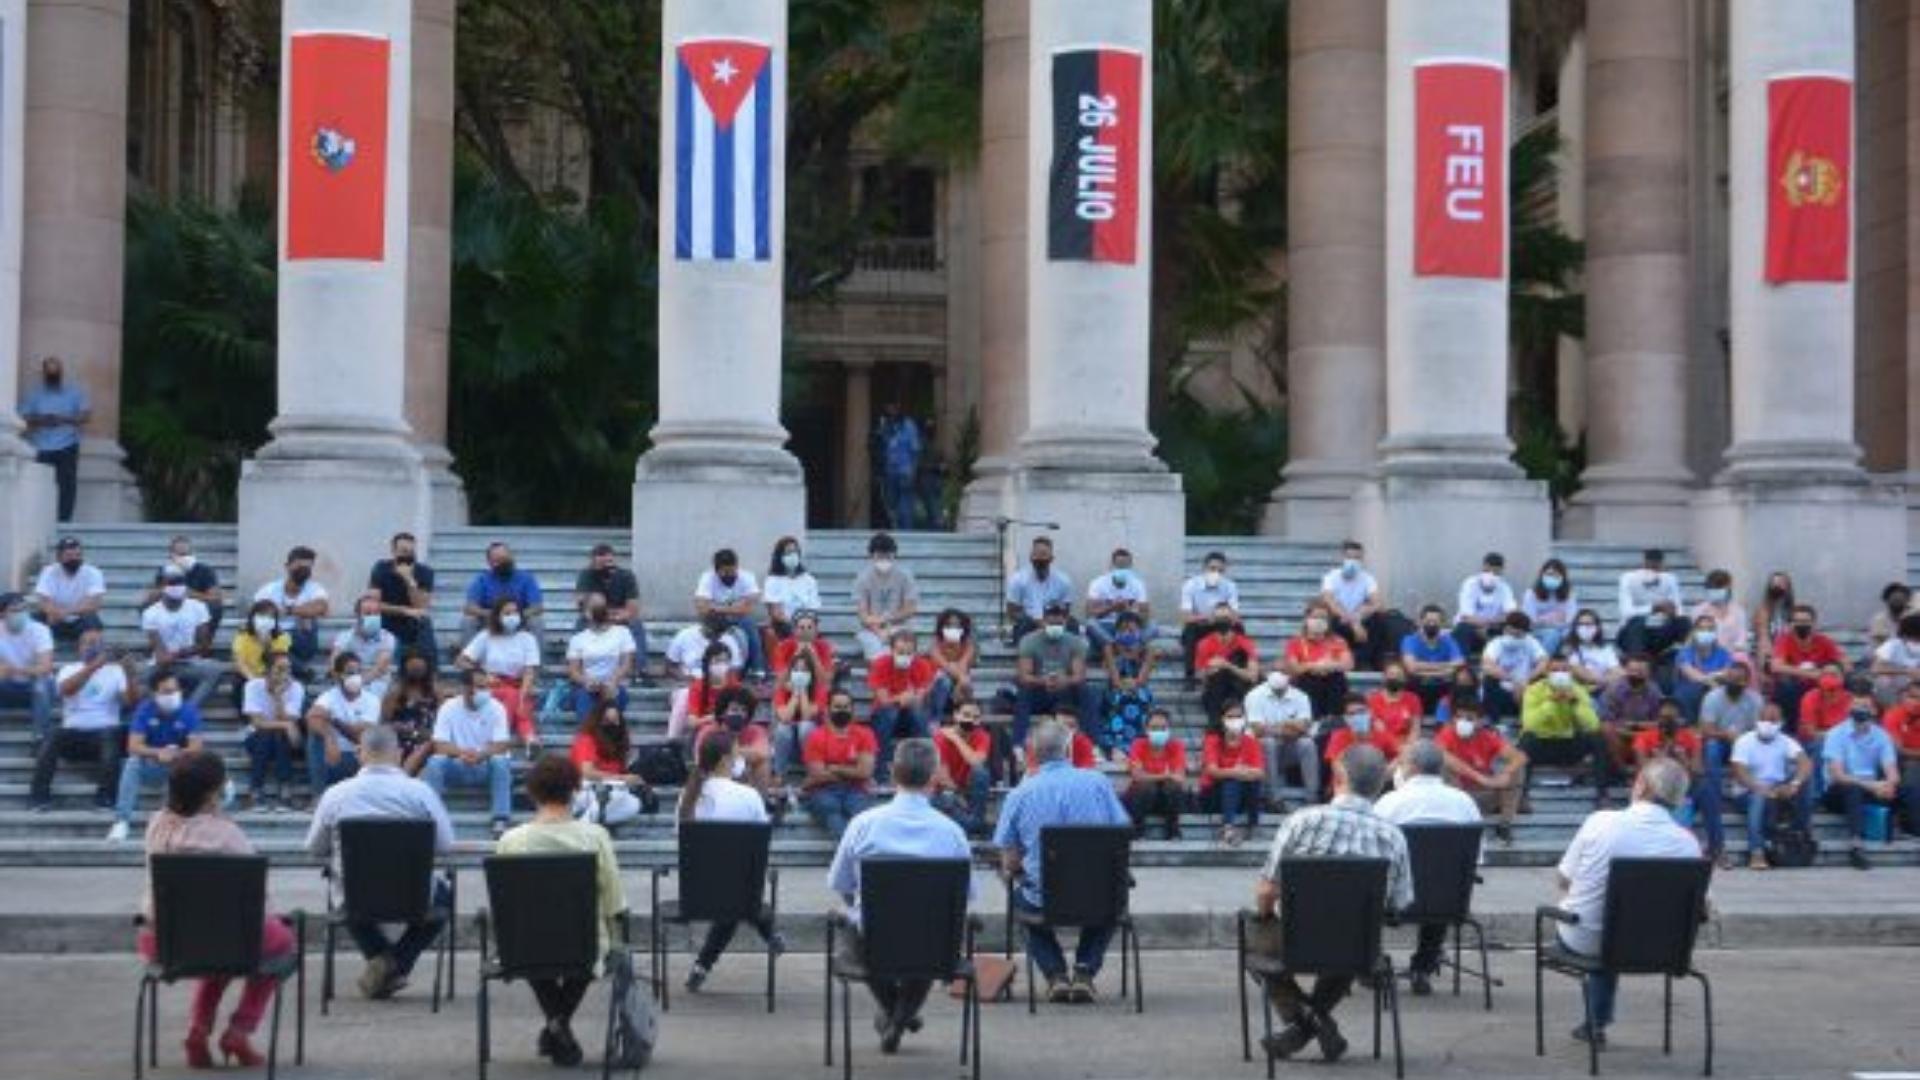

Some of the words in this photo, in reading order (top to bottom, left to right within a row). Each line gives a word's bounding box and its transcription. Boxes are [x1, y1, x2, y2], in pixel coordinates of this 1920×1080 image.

[1078, 93, 1118, 128] 26
[1075, 135, 1118, 220] JULIO
[1445, 125, 1484, 221] FEU
